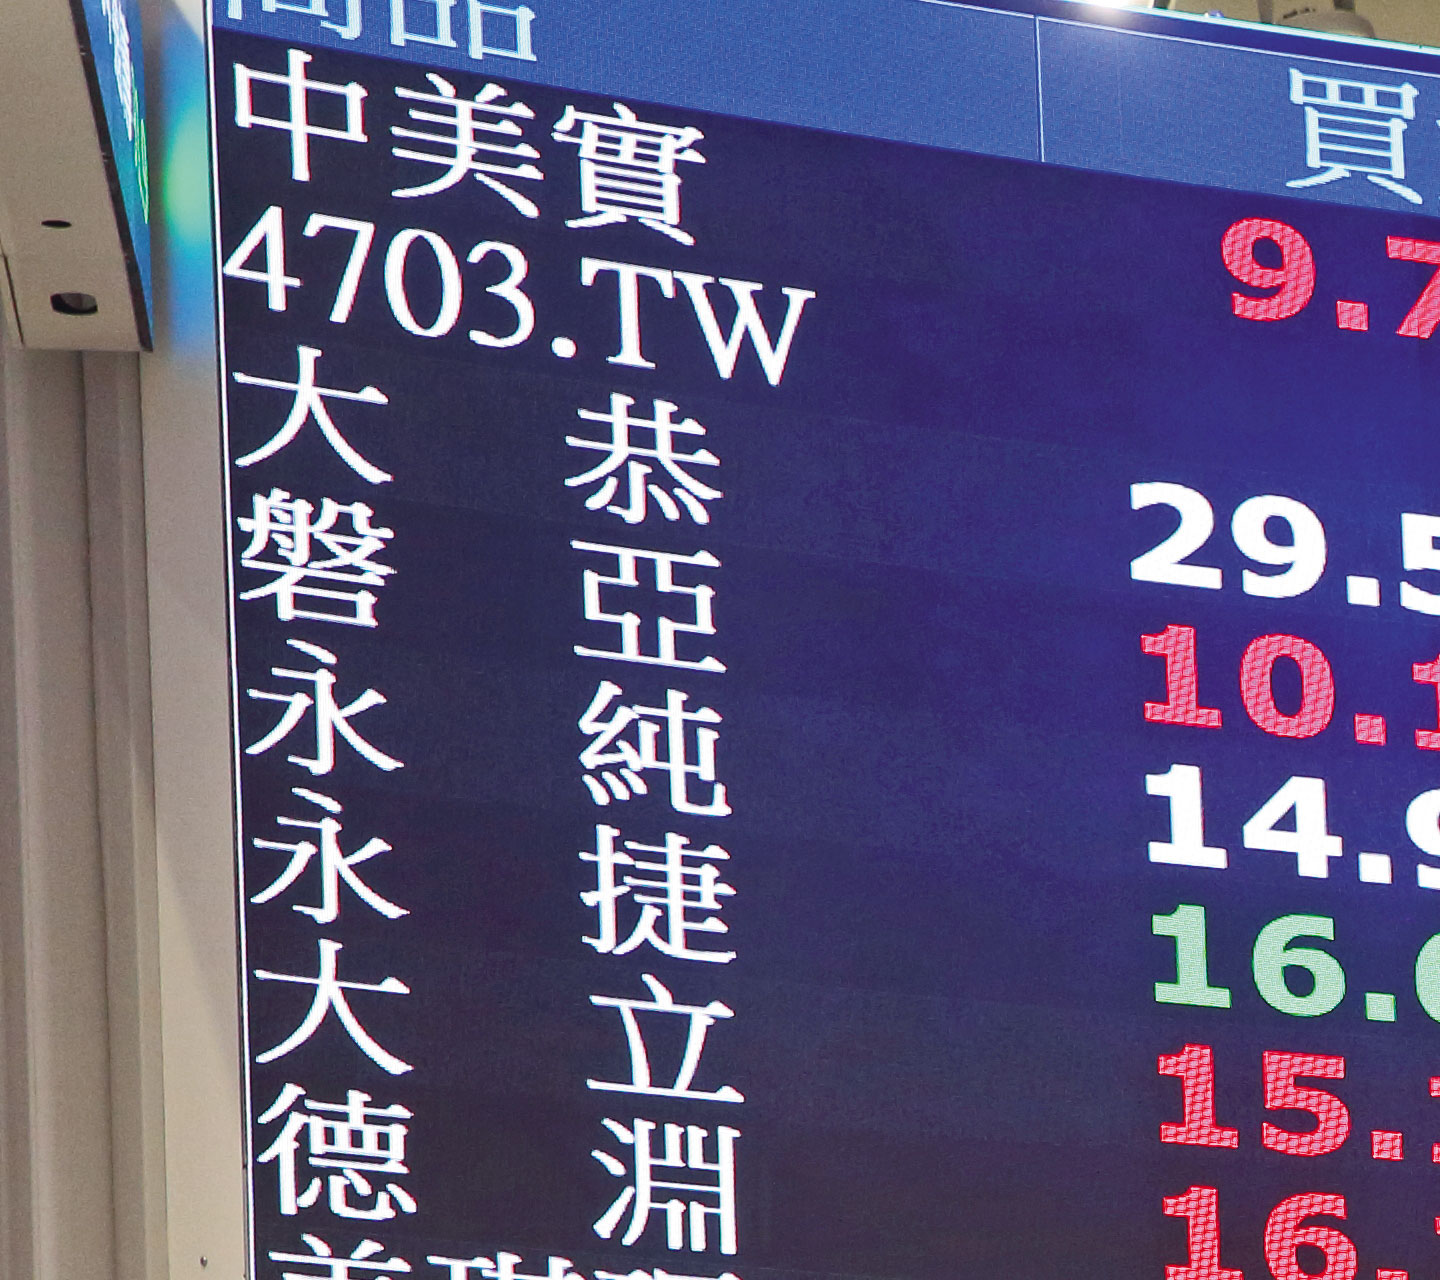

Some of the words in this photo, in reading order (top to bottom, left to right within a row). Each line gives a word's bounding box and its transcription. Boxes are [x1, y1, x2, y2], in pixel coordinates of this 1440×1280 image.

[233, 49, 706, 245] 中美實
[220, 202, 816, 389] 4703.TW
[233, 345, 394, 484] 大
[564, 392, 724, 525] 恭
[237, 487, 397, 628] 磐
[570, 540, 727, 673] 亞
[246, 639, 404, 776] 永
[578, 681, 732, 816] 純
[251, 788, 410, 924] 永
[579, 824, 736, 963] 捷
[254, 939, 414, 1075] 大
[587, 974, 744, 1103] 立
[257, 1083, 417, 1220] 德
[591, 1118, 741, 1254] 淵
